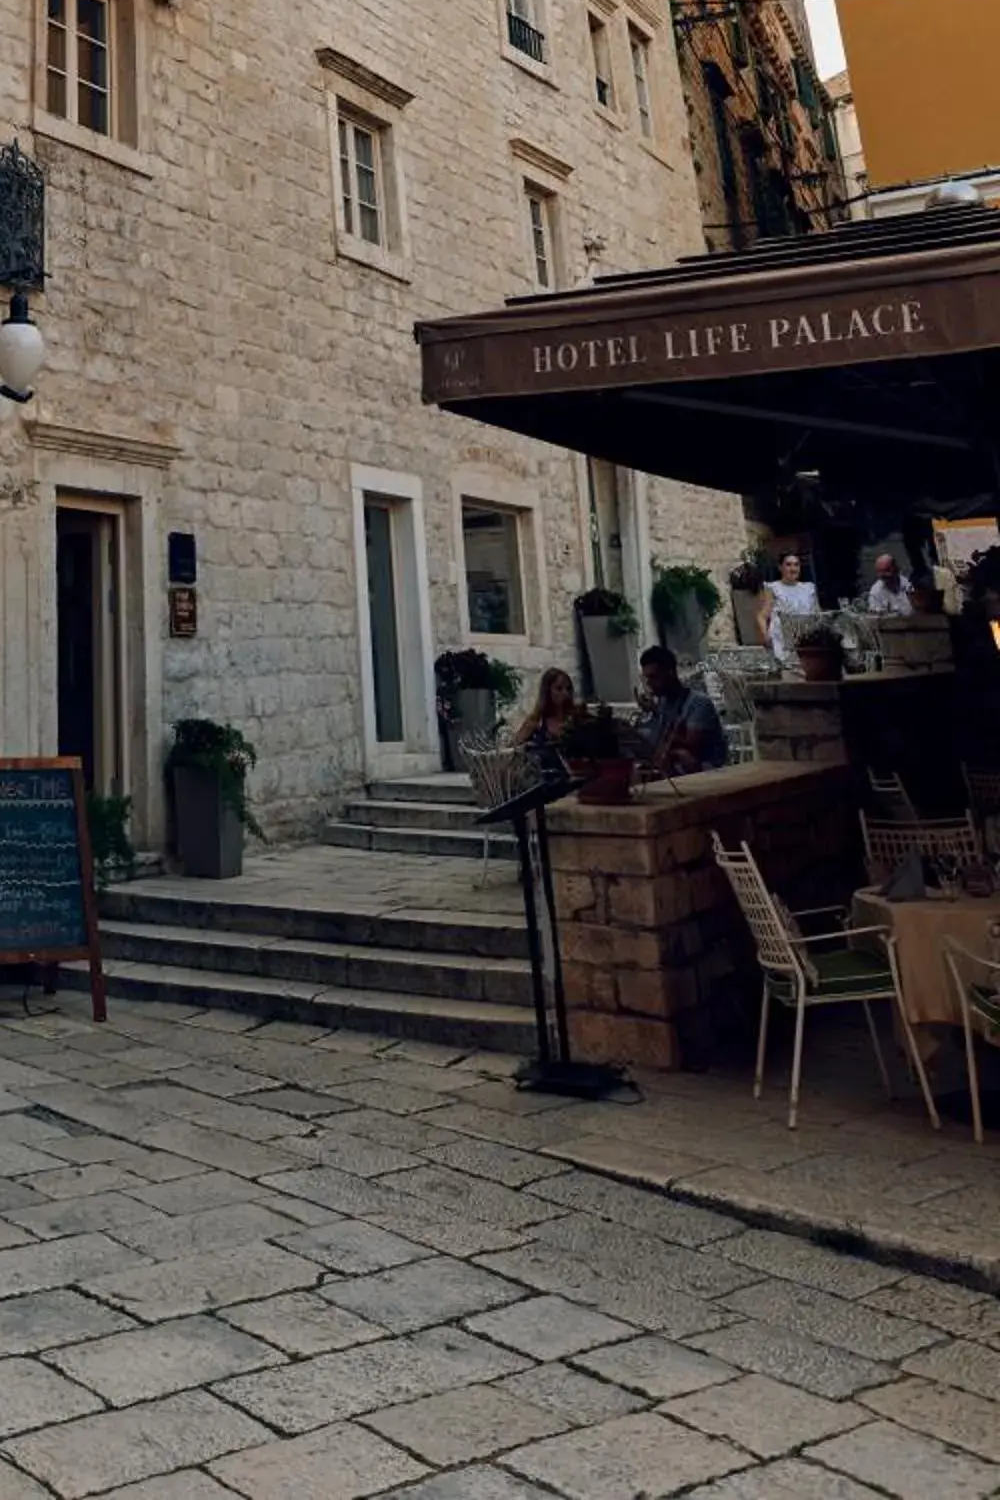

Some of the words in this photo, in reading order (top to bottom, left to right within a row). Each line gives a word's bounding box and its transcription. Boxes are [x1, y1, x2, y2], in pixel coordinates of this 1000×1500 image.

[532, 335, 648, 373] HOTEL
[664, 322, 751, 360] LIFE
[768, 301, 925, 349] PALACE
